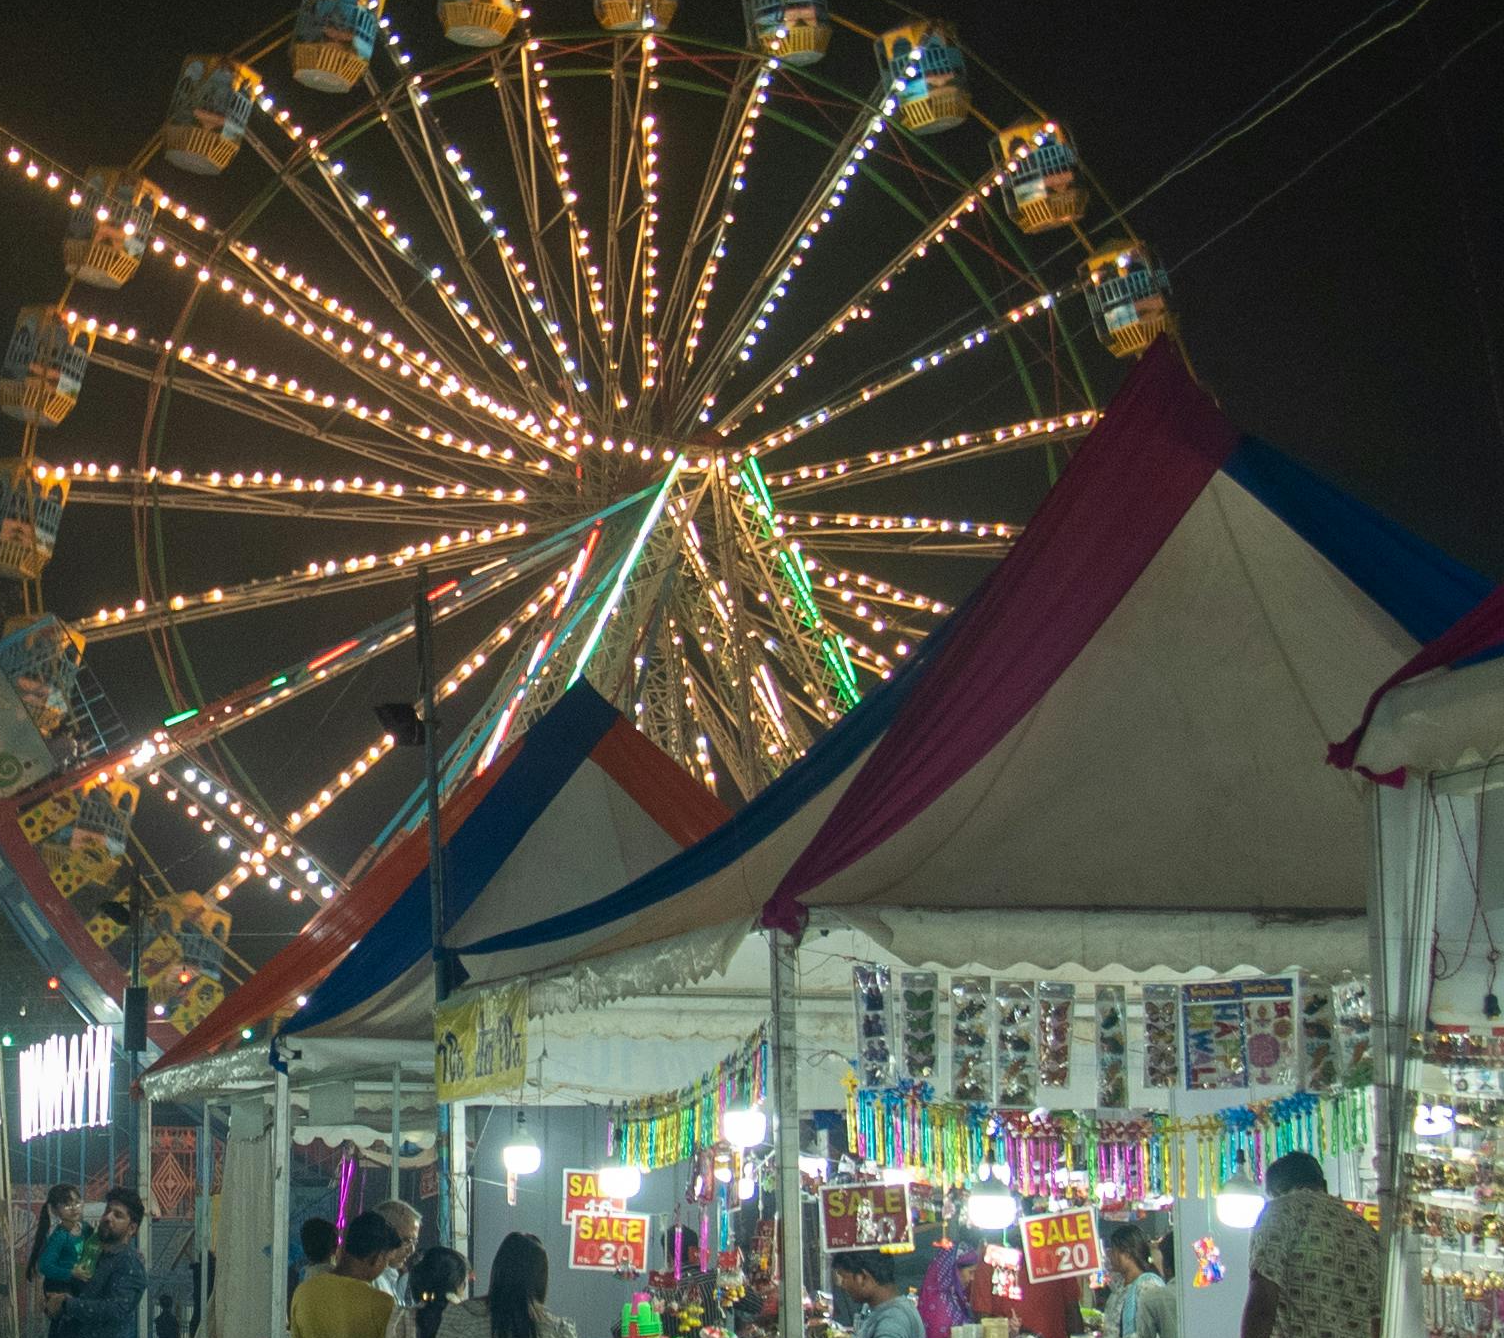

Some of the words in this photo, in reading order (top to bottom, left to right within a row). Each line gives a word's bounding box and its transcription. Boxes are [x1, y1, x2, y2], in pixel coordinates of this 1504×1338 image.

[828, 1187, 902, 1218] SALE
[578, 1216, 642, 1243] SALE
[1028, 1213, 1092, 1249] SALE
[598, 1243, 635, 1267] 20
[1055, 1243, 1090, 1271] 20
